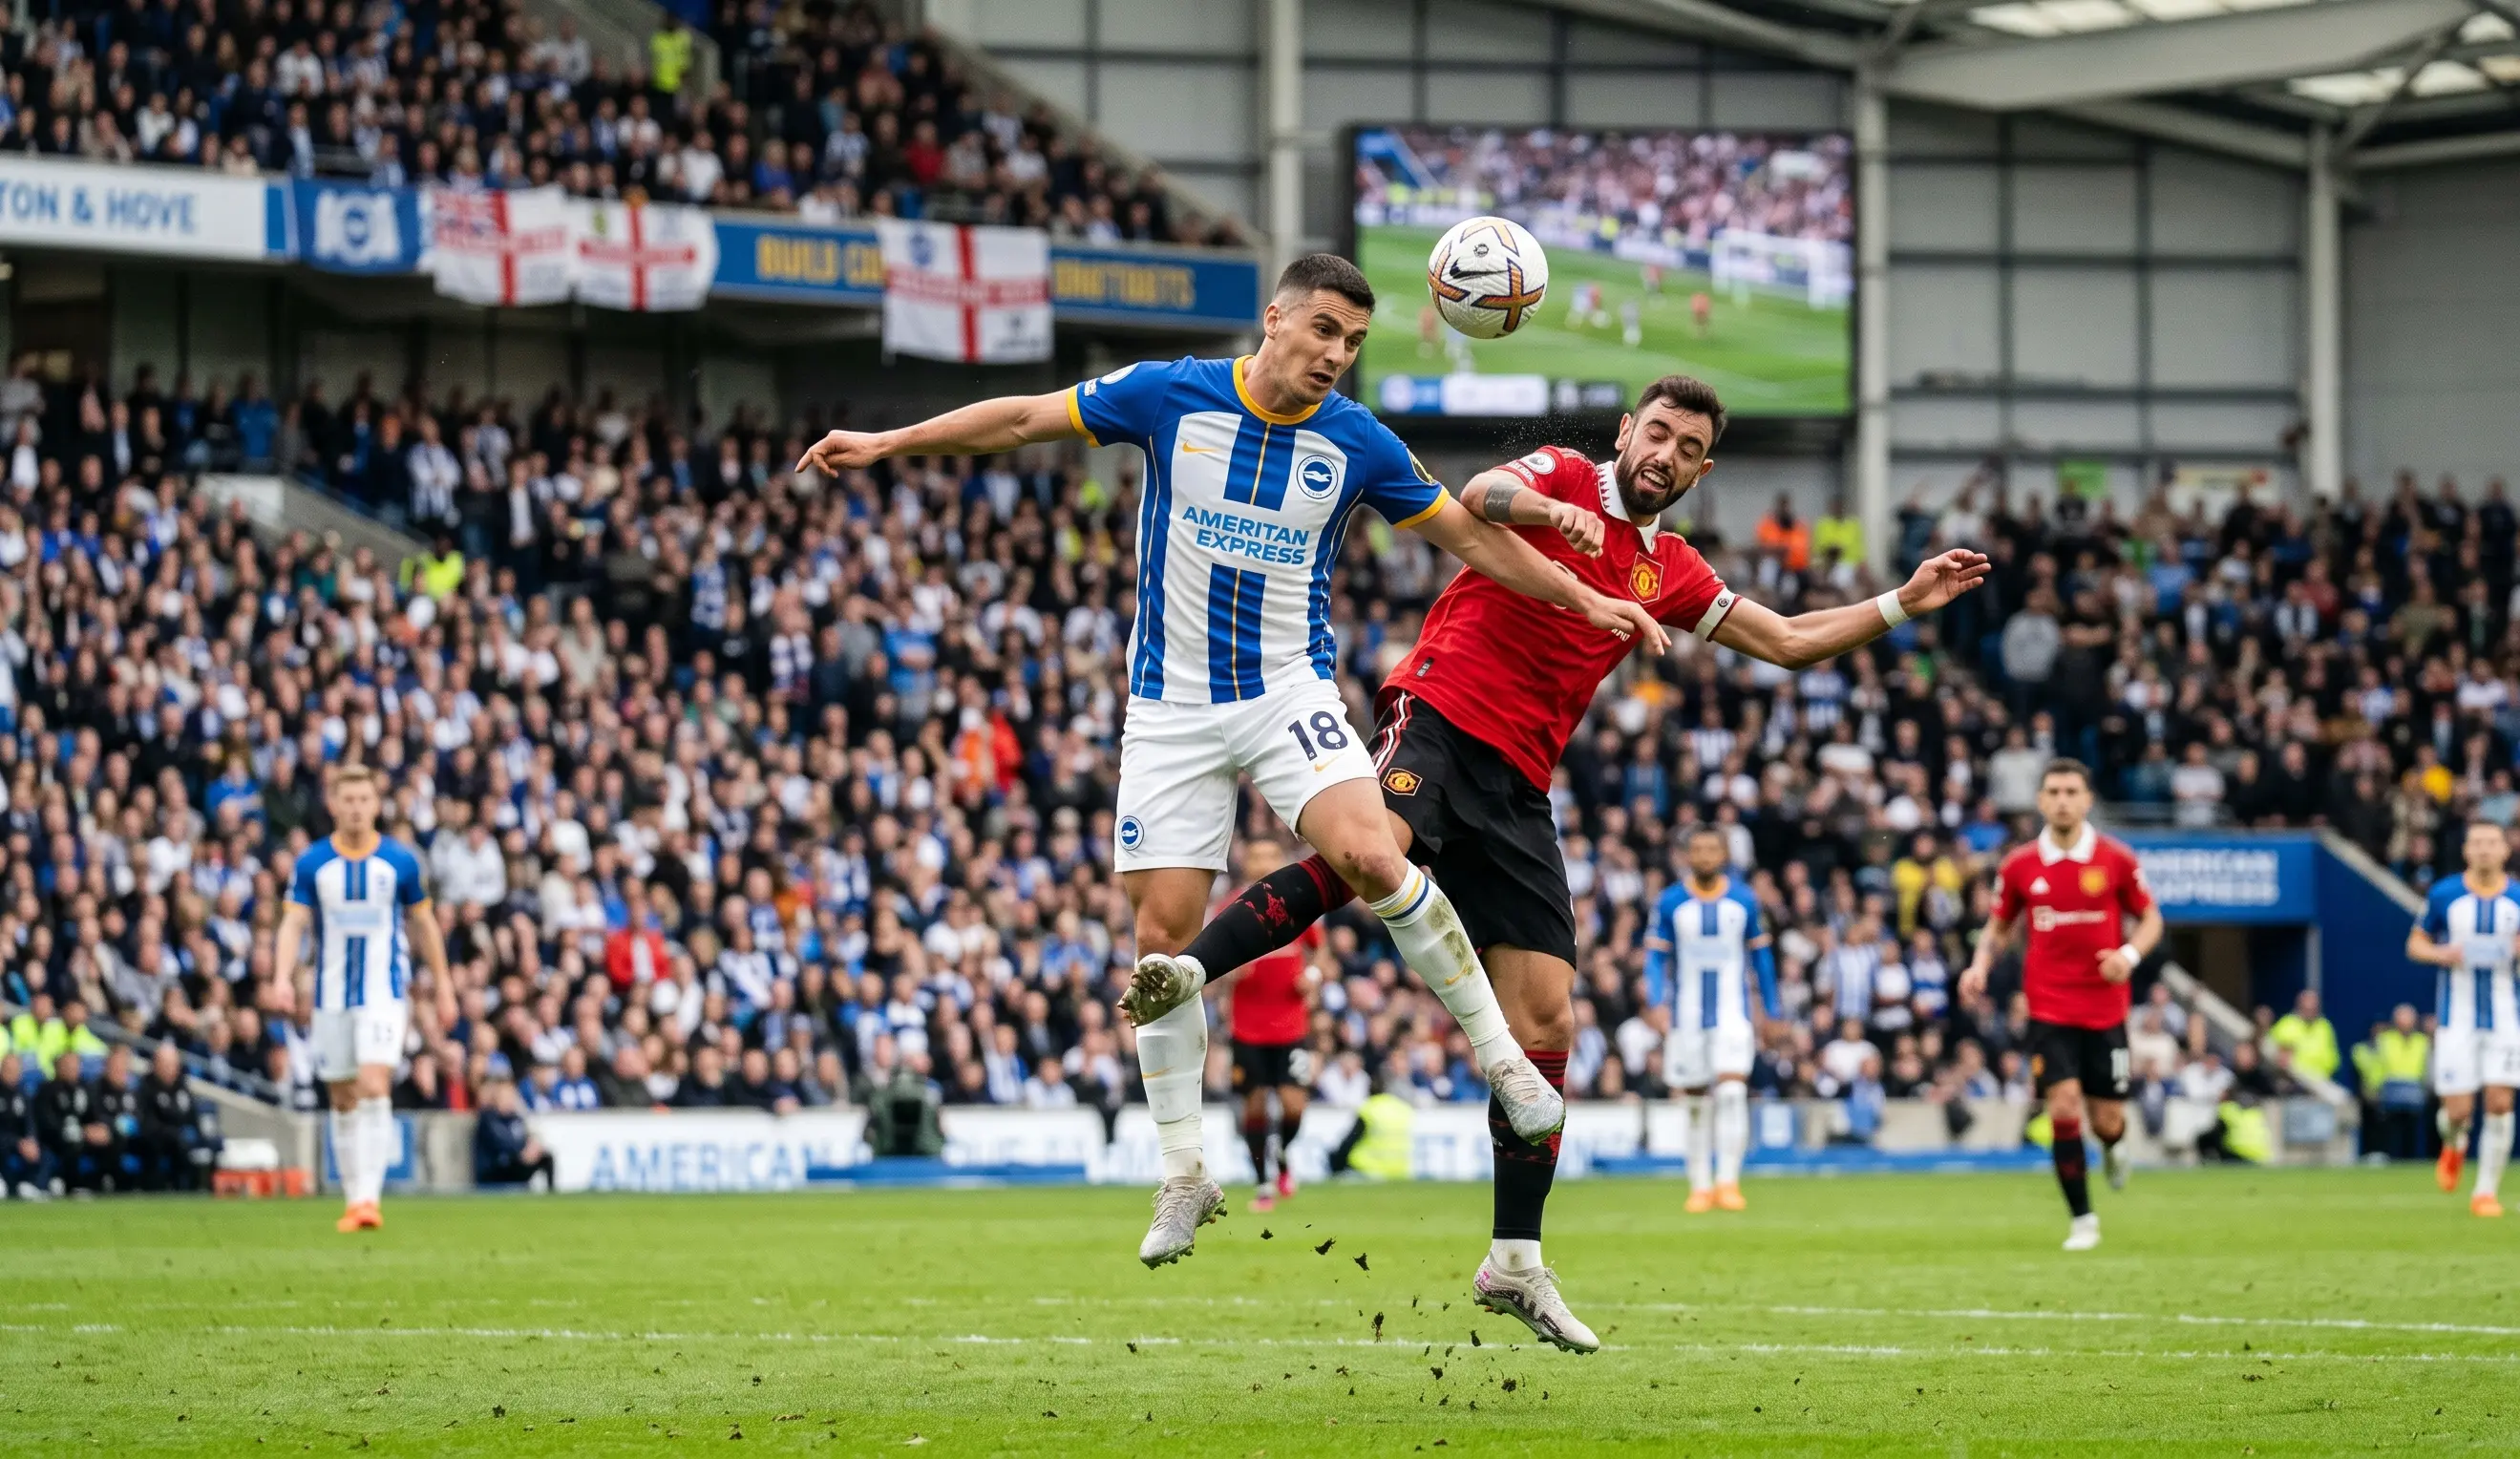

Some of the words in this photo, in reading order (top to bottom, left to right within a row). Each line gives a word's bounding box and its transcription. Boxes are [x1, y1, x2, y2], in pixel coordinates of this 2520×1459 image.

[72, 185, 95, 225] &
[106, 188, 197, 234] HOVE
[1182, 505, 1310, 546] AMERITAN
[1196, 528, 1306, 565] EXPRESS
[1287, 710, 1348, 762] 18
